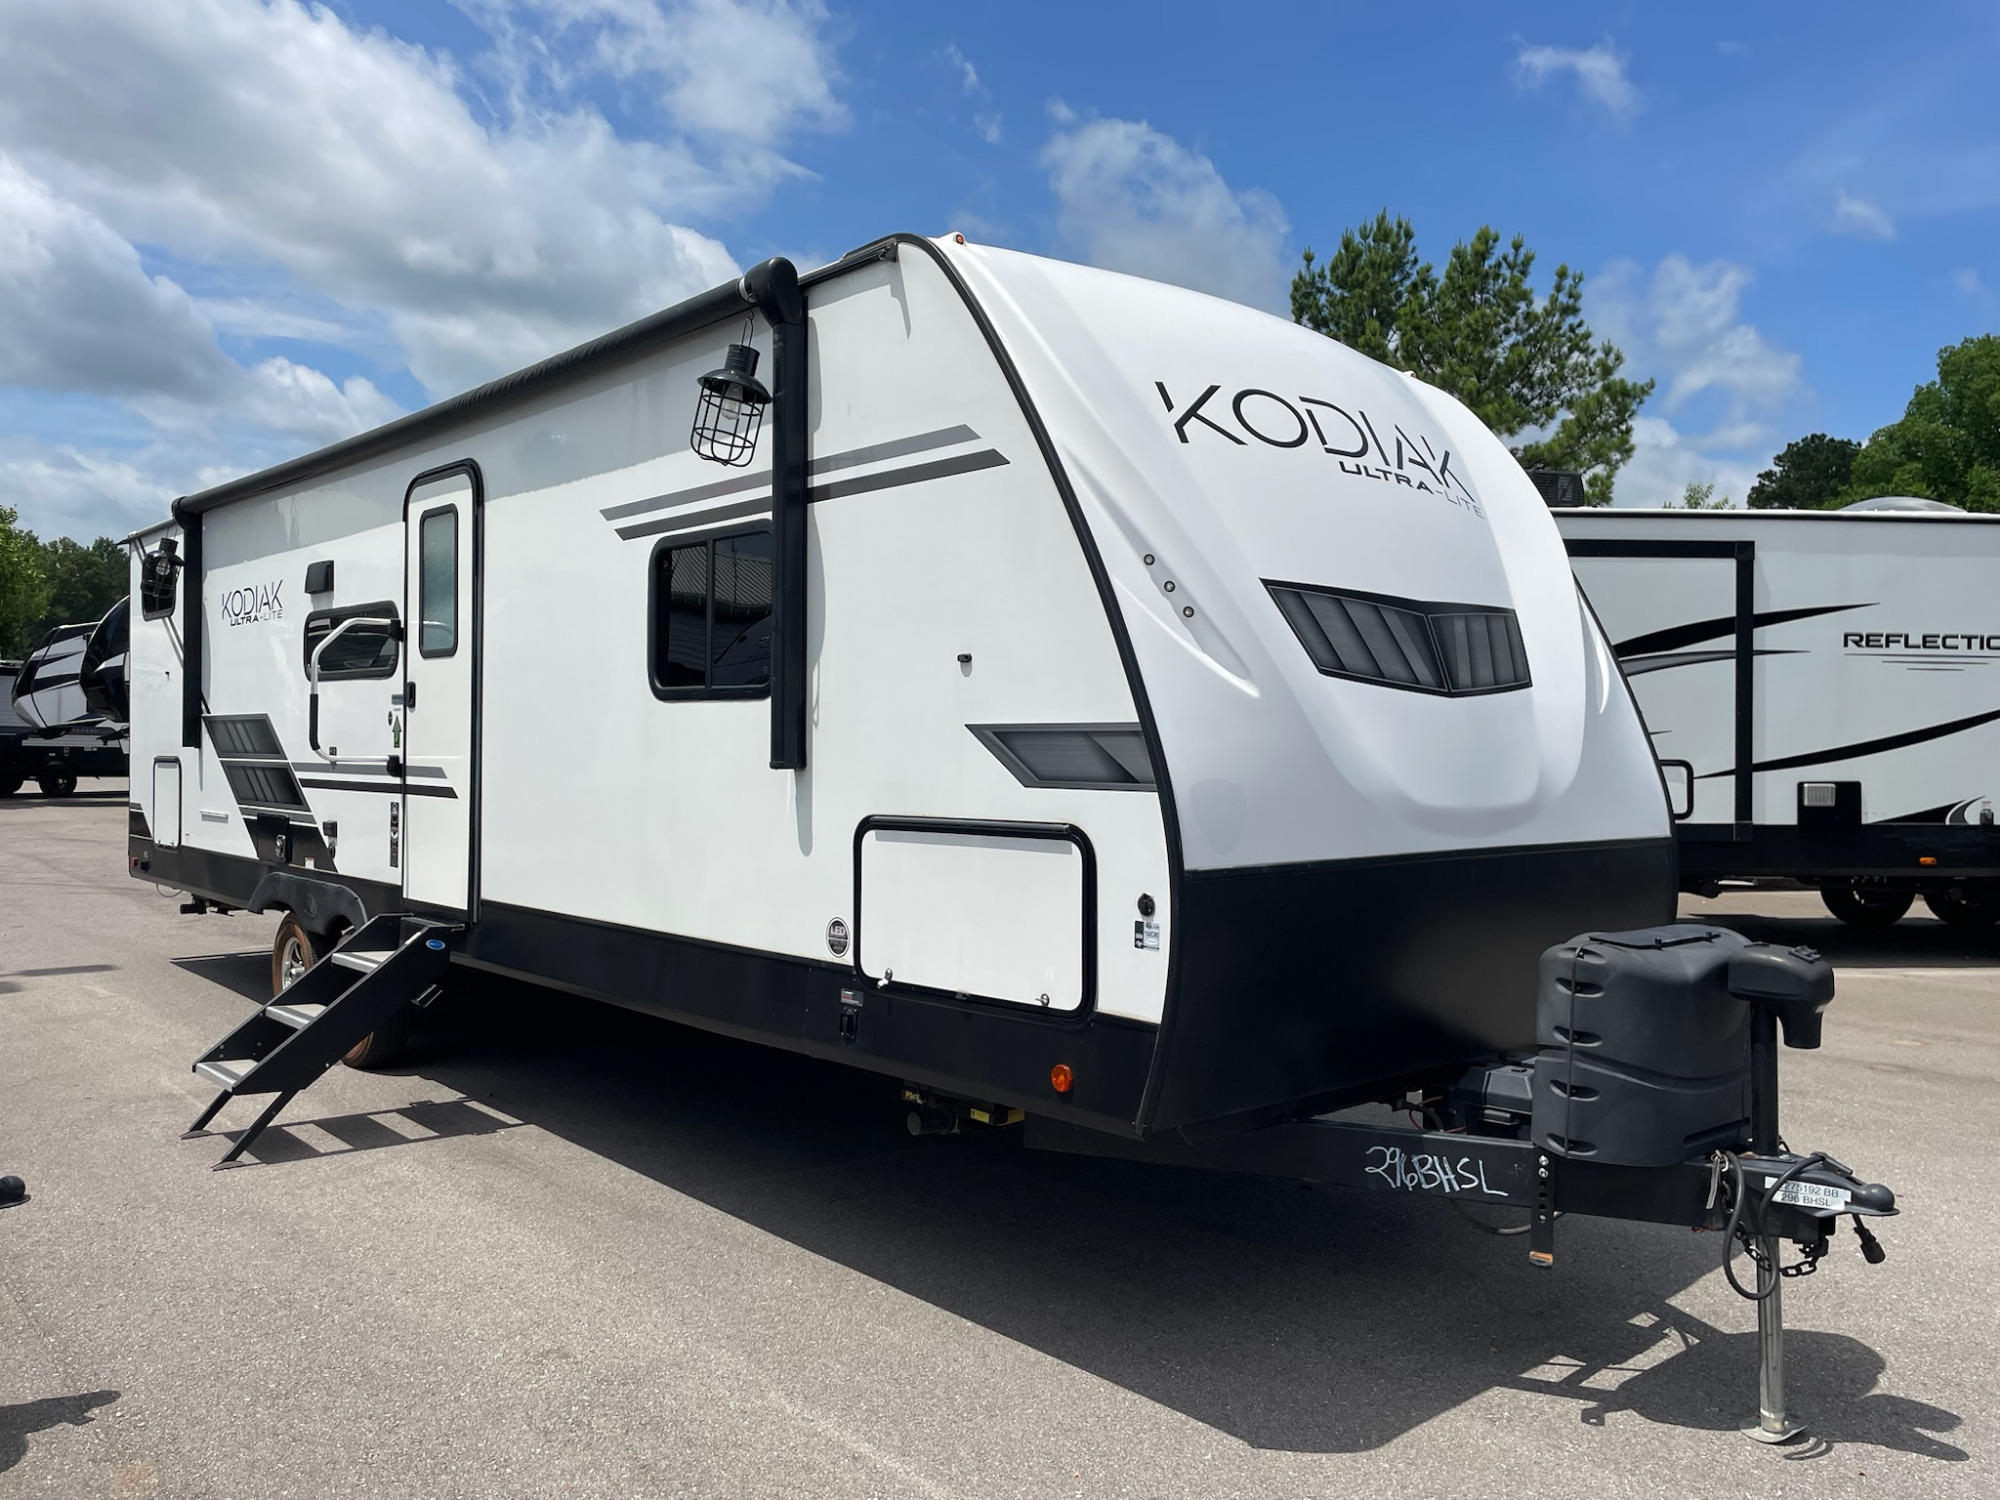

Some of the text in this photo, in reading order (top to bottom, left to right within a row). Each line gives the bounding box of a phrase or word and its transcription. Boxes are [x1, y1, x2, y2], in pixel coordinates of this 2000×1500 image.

[1154, 381, 1475, 502] KODIAK
[1338, 460, 1485, 519] ULTRA-LITE
[222, 579, 283, 620] KODIAK
[230, 608, 283, 627] ULTRA-LITE
[830, 925, 846, 936] LED
[1365, 1146, 1508, 1196] 296BHSL
[1779, 1181, 1839, 1198] 275192 BB
[1781, 1192, 1832, 1207] 296 BHSL
